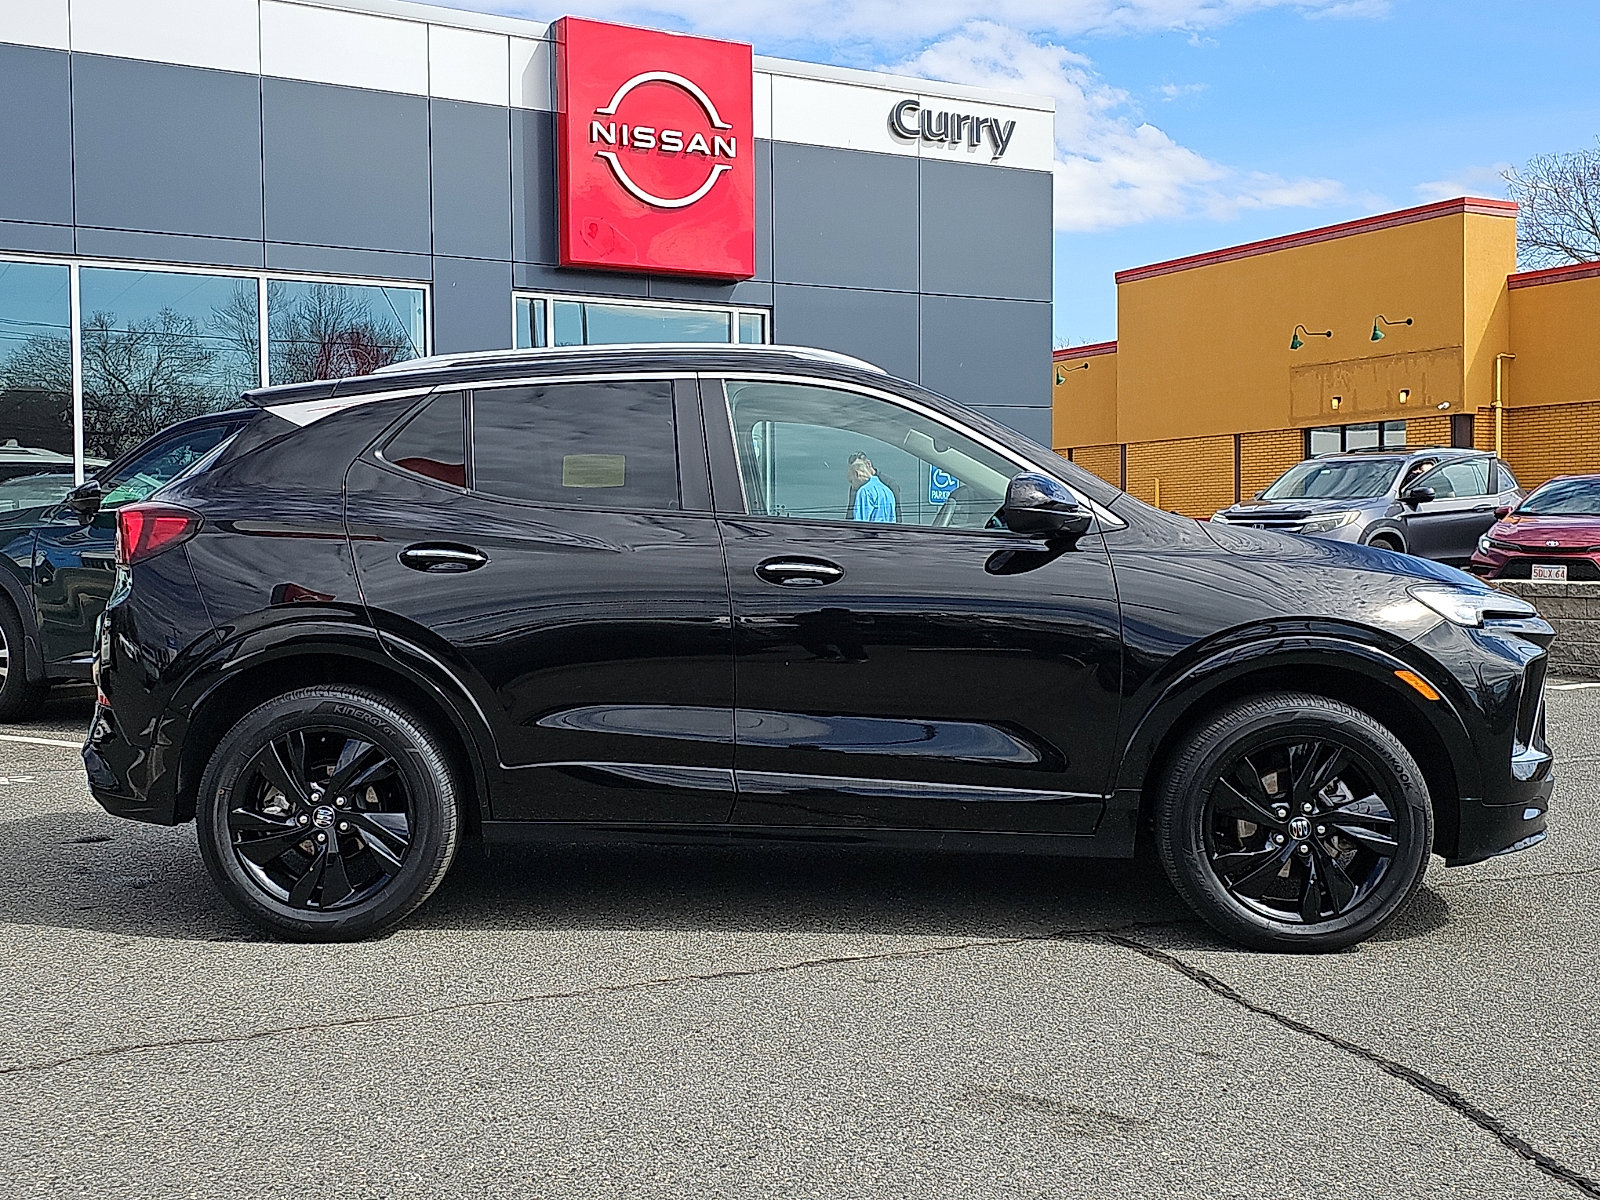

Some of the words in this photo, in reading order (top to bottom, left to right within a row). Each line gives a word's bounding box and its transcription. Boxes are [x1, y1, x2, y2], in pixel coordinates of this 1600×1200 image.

[590, 120, 736, 158] NISSAN
[889, 99, 1016, 158] Curry
[333, 704, 386, 727] KINERGY
[383, 726, 396, 736] GT
